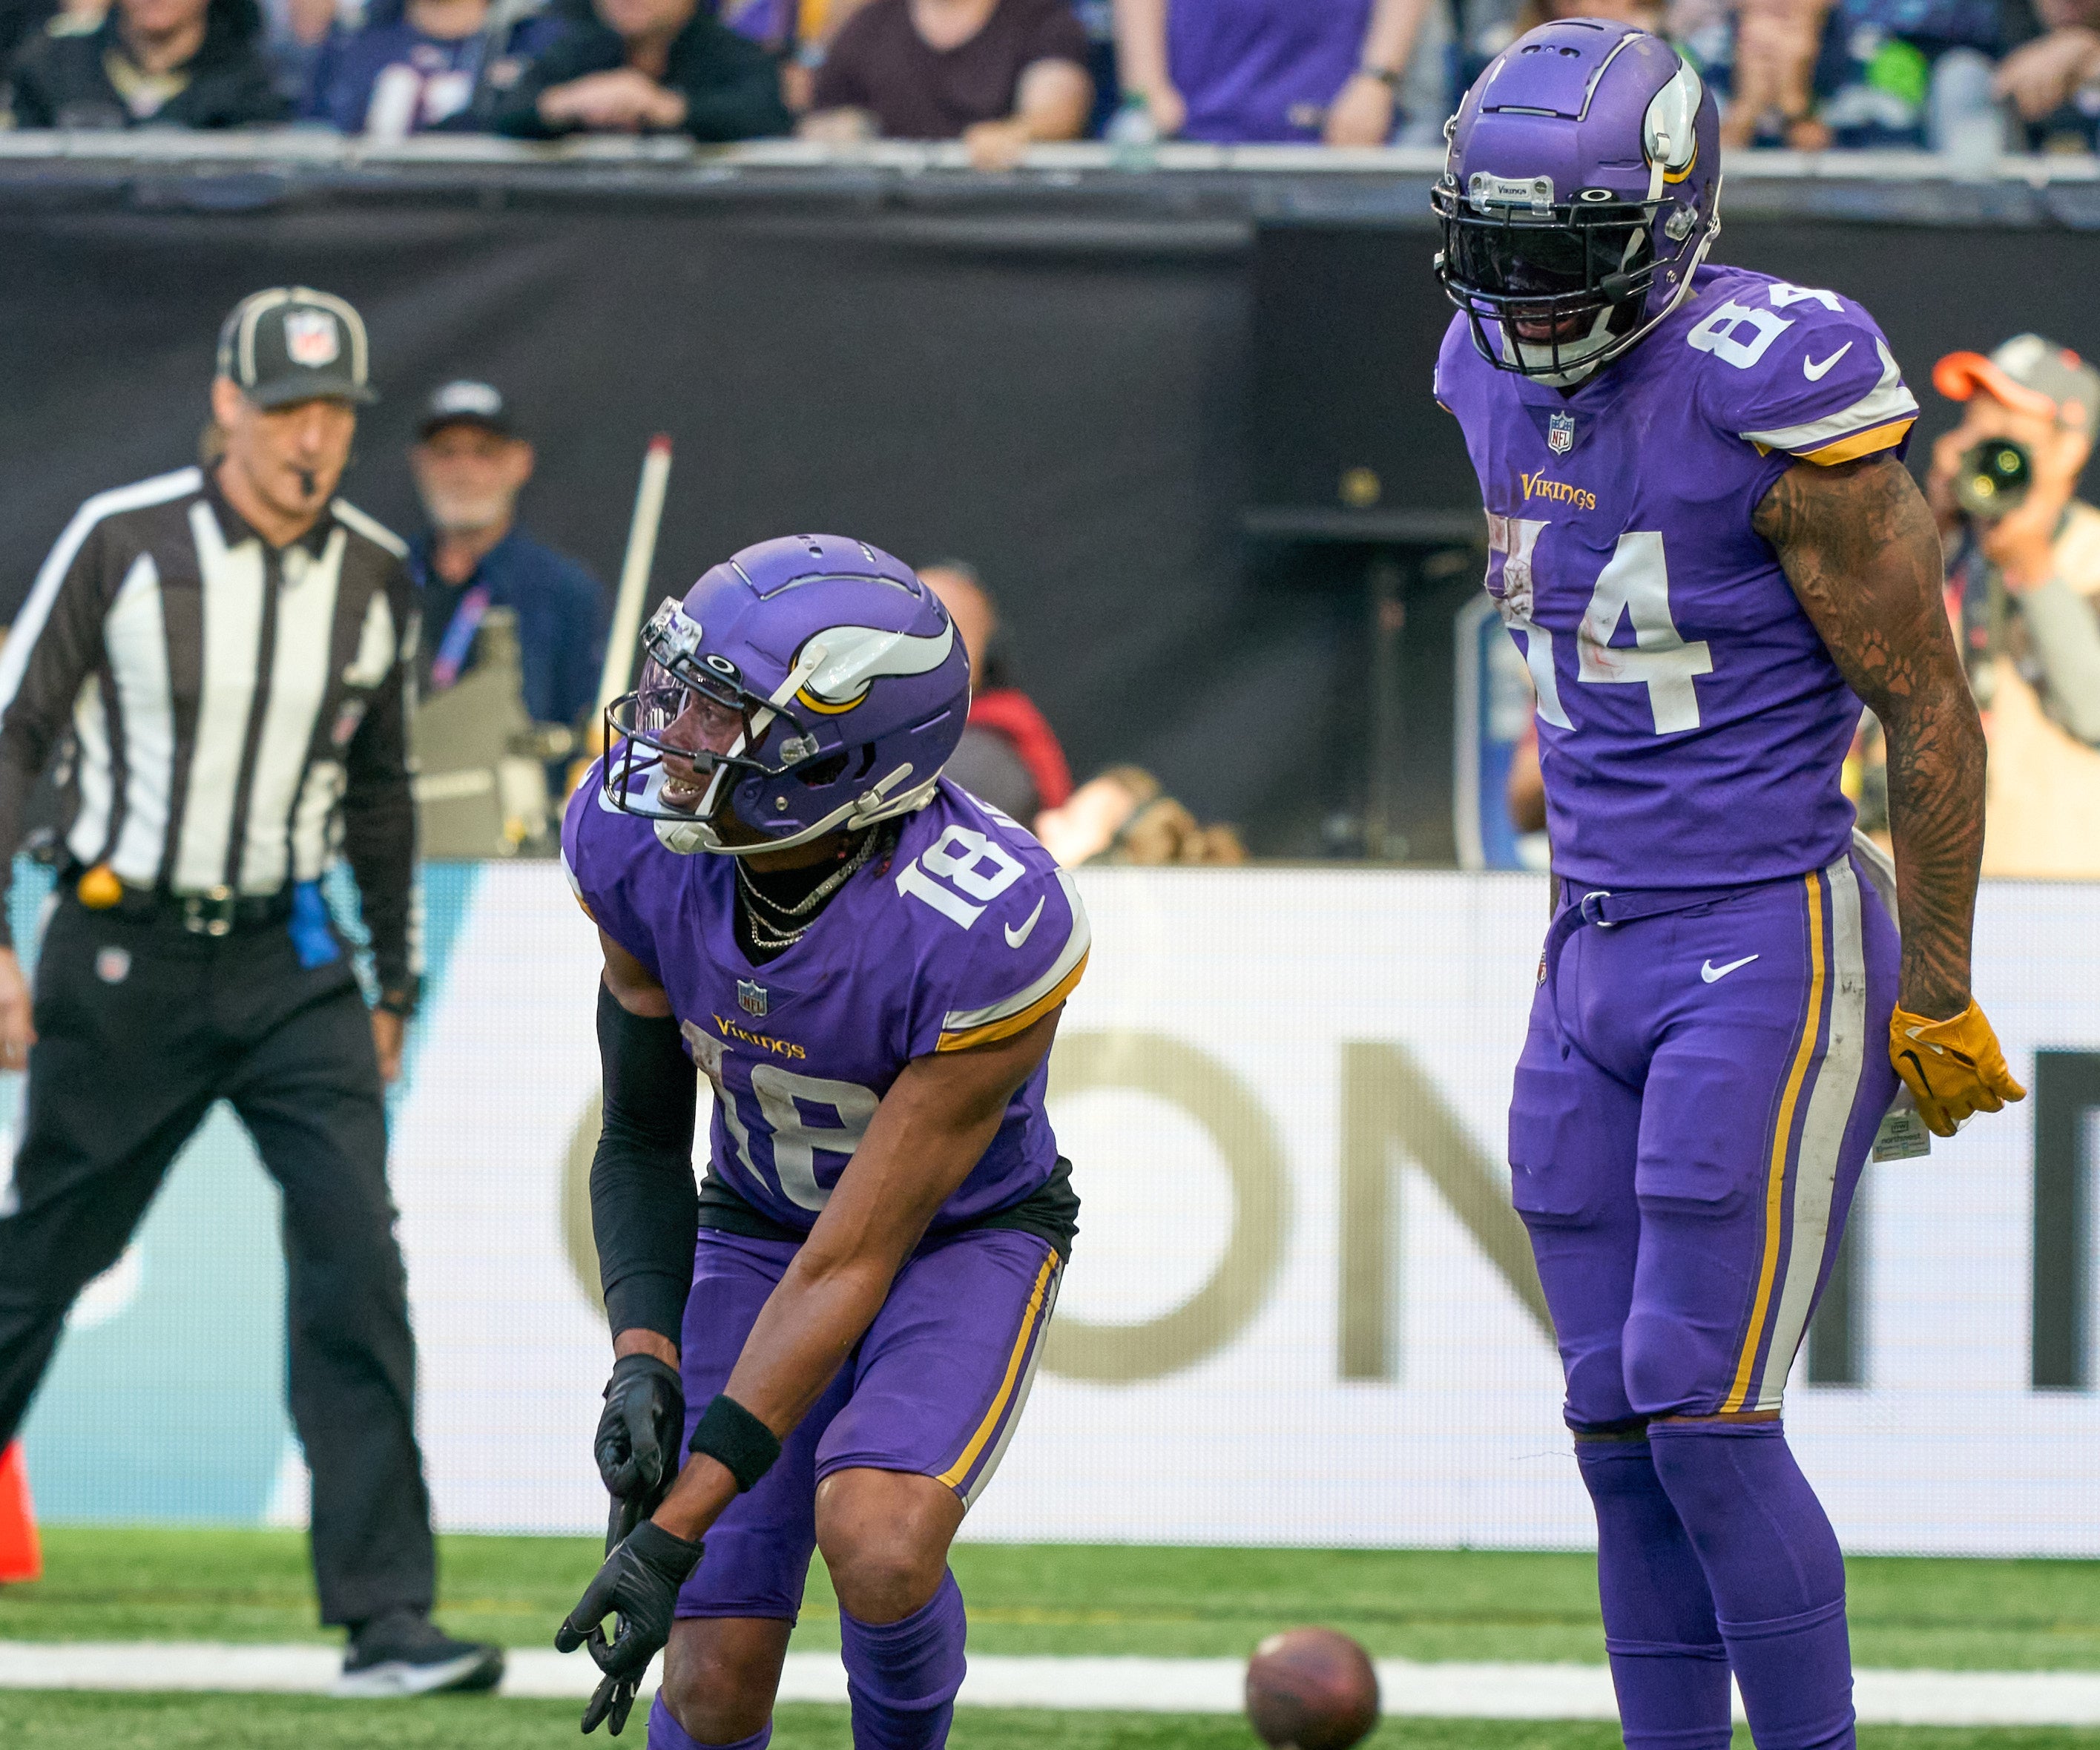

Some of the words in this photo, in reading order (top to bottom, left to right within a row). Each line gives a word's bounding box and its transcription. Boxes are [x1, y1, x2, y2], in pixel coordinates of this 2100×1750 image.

[1687, 283, 1845, 369] 84
[1551, 430, 1568, 447] NFL
[895, 825, 1026, 931] 18
